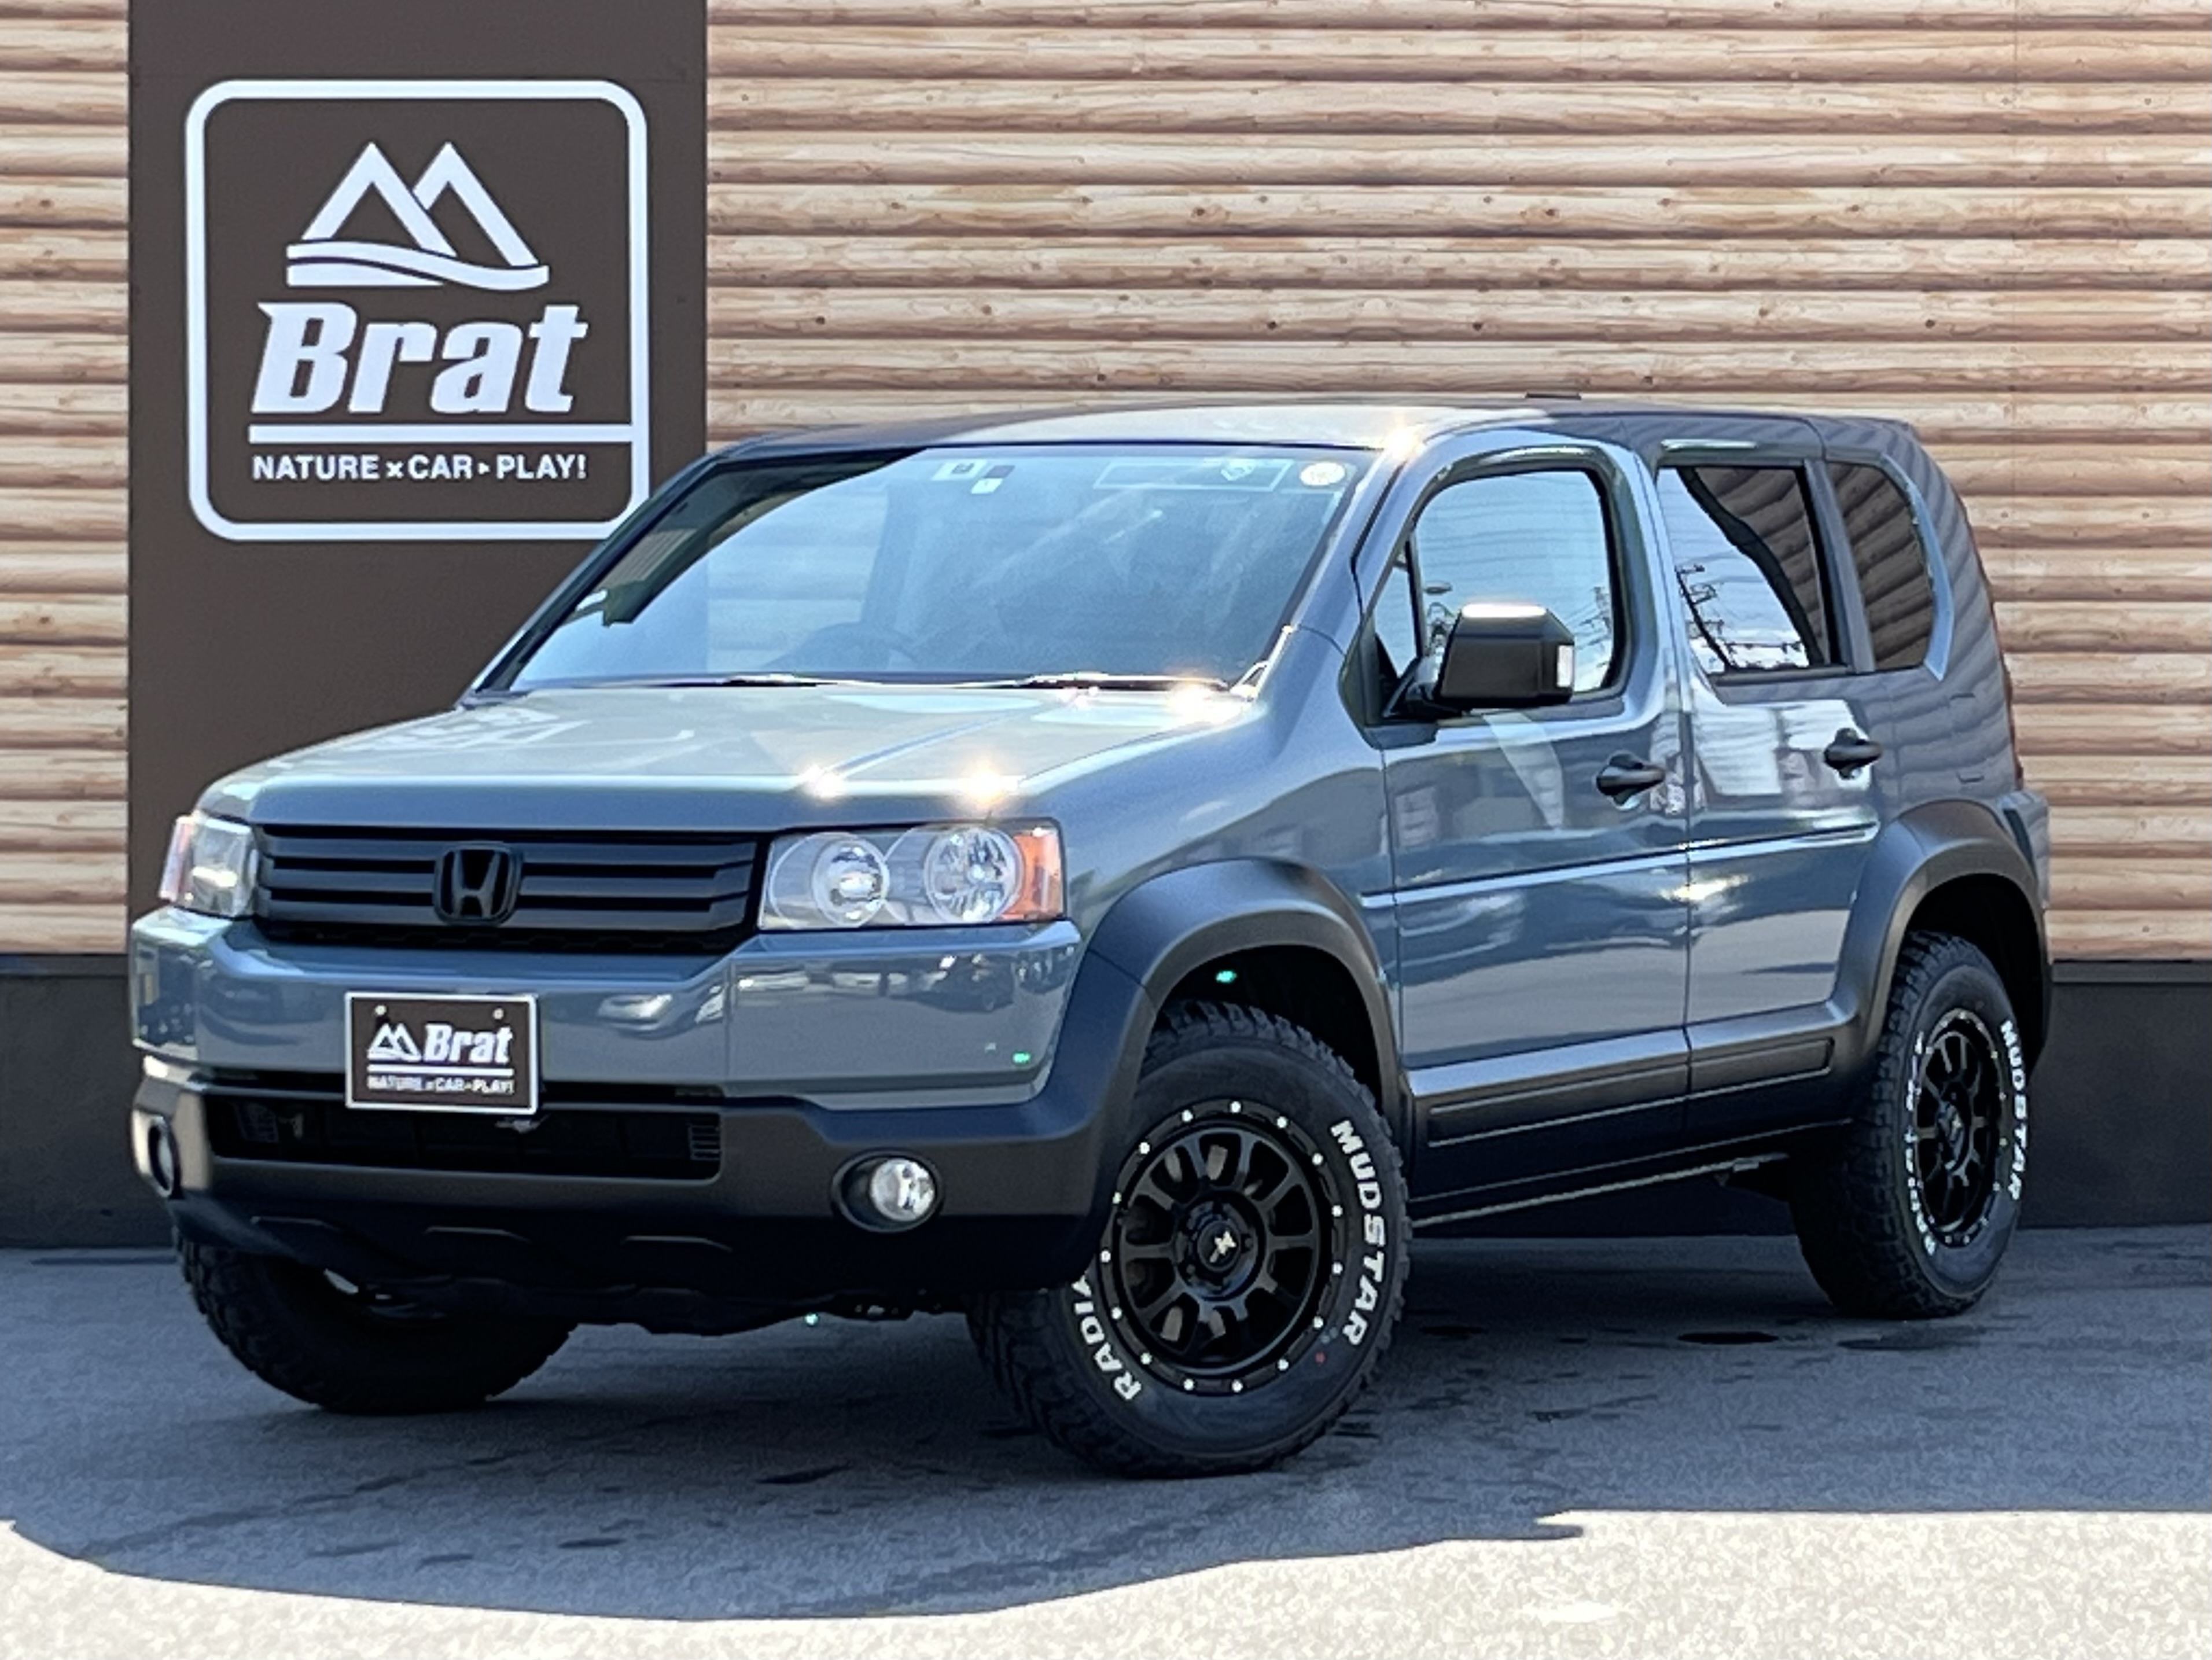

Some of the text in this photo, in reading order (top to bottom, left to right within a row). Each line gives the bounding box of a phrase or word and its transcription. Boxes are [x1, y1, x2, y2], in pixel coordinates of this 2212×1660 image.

[251, 302, 588, 413] Brat
[253, 454, 380, 480] NATURE
[408, 454, 472, 480] CAR
[496, 454, 586, 480] PLAY!
[423, 1022, 513, 1065] Brat
[1331, 1120, 1386, 1346] MUDSTAR
